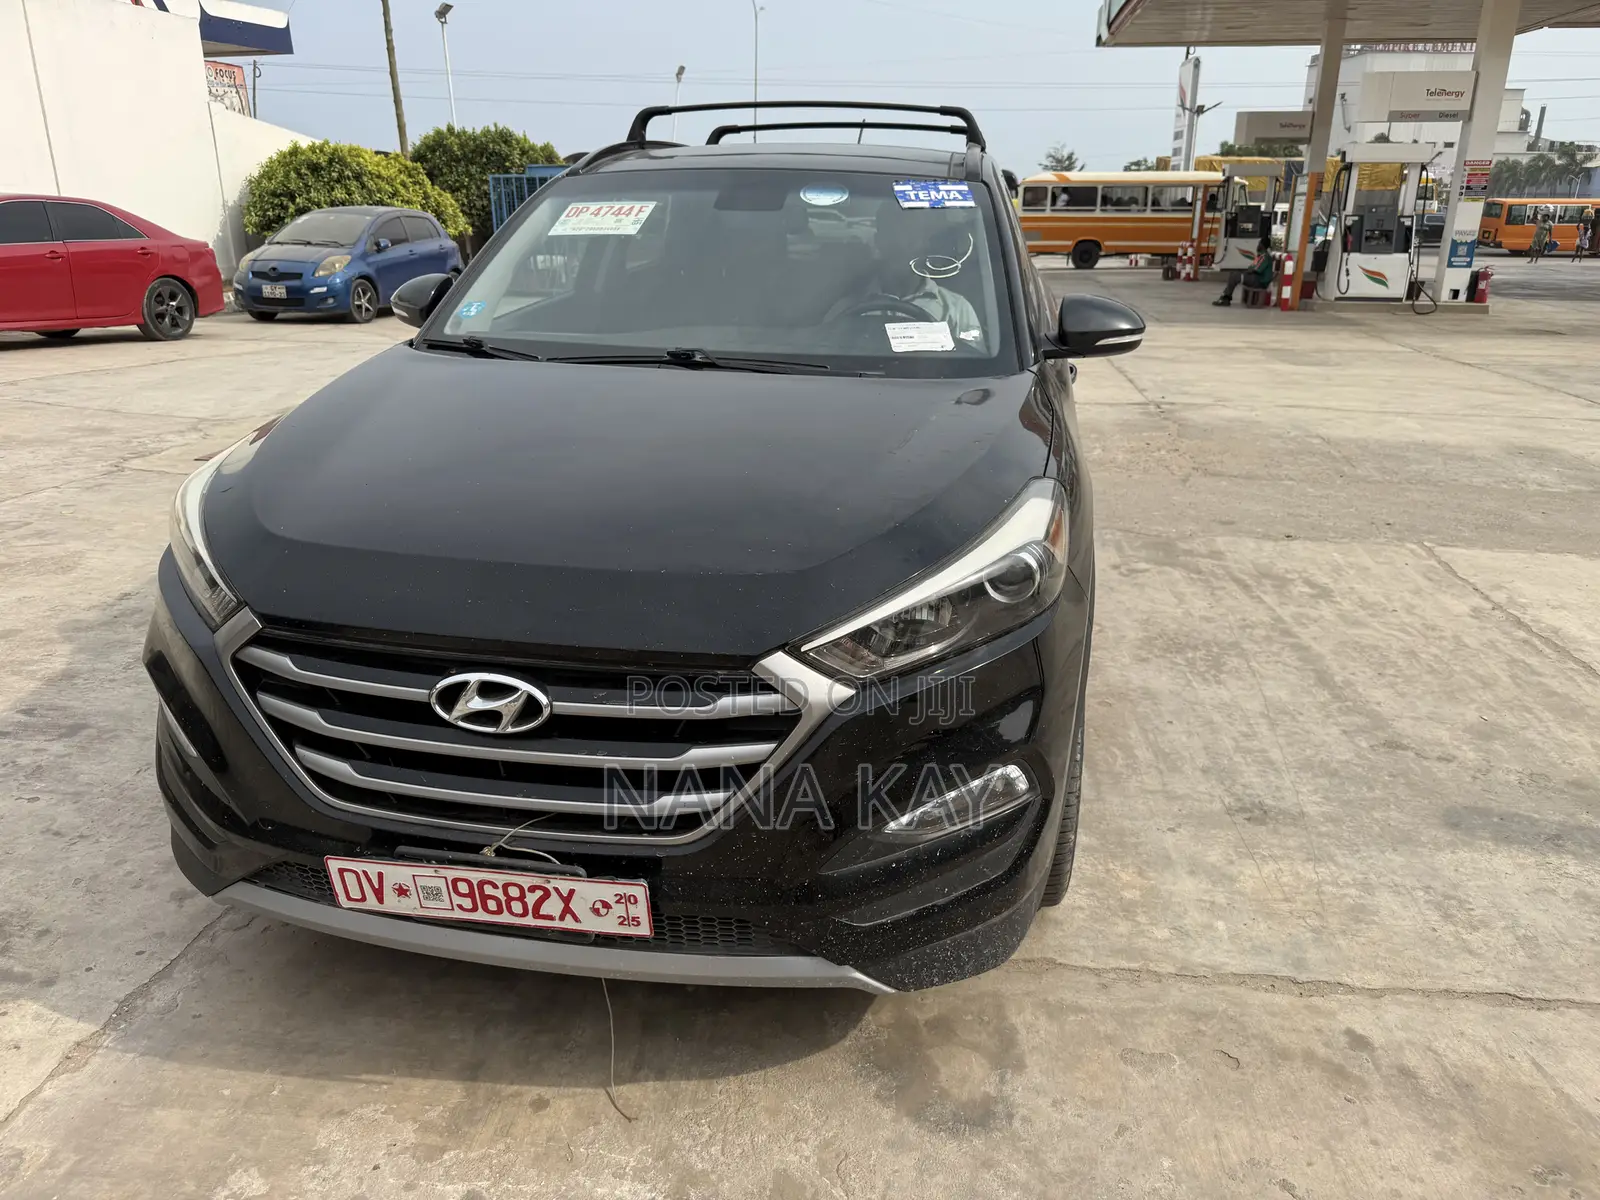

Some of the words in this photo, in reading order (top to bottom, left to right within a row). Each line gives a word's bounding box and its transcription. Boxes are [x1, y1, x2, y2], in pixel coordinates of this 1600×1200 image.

[214, 67, 236, 80] FOCUS
[1425, 88, 1465, 98] Telenergy
[1399, 111, 1421, 119] Super
[1438, 111, 1459, 119] Diesel
[904, 190, 963, 200] TEMA
[565, 206, 591, 218] DP
[590, 205, 636, 218] 4744
[634, 205, 650, 217] F
[337, 867, 385, 905] DV
[450, 876, 582, 924] 9682X
